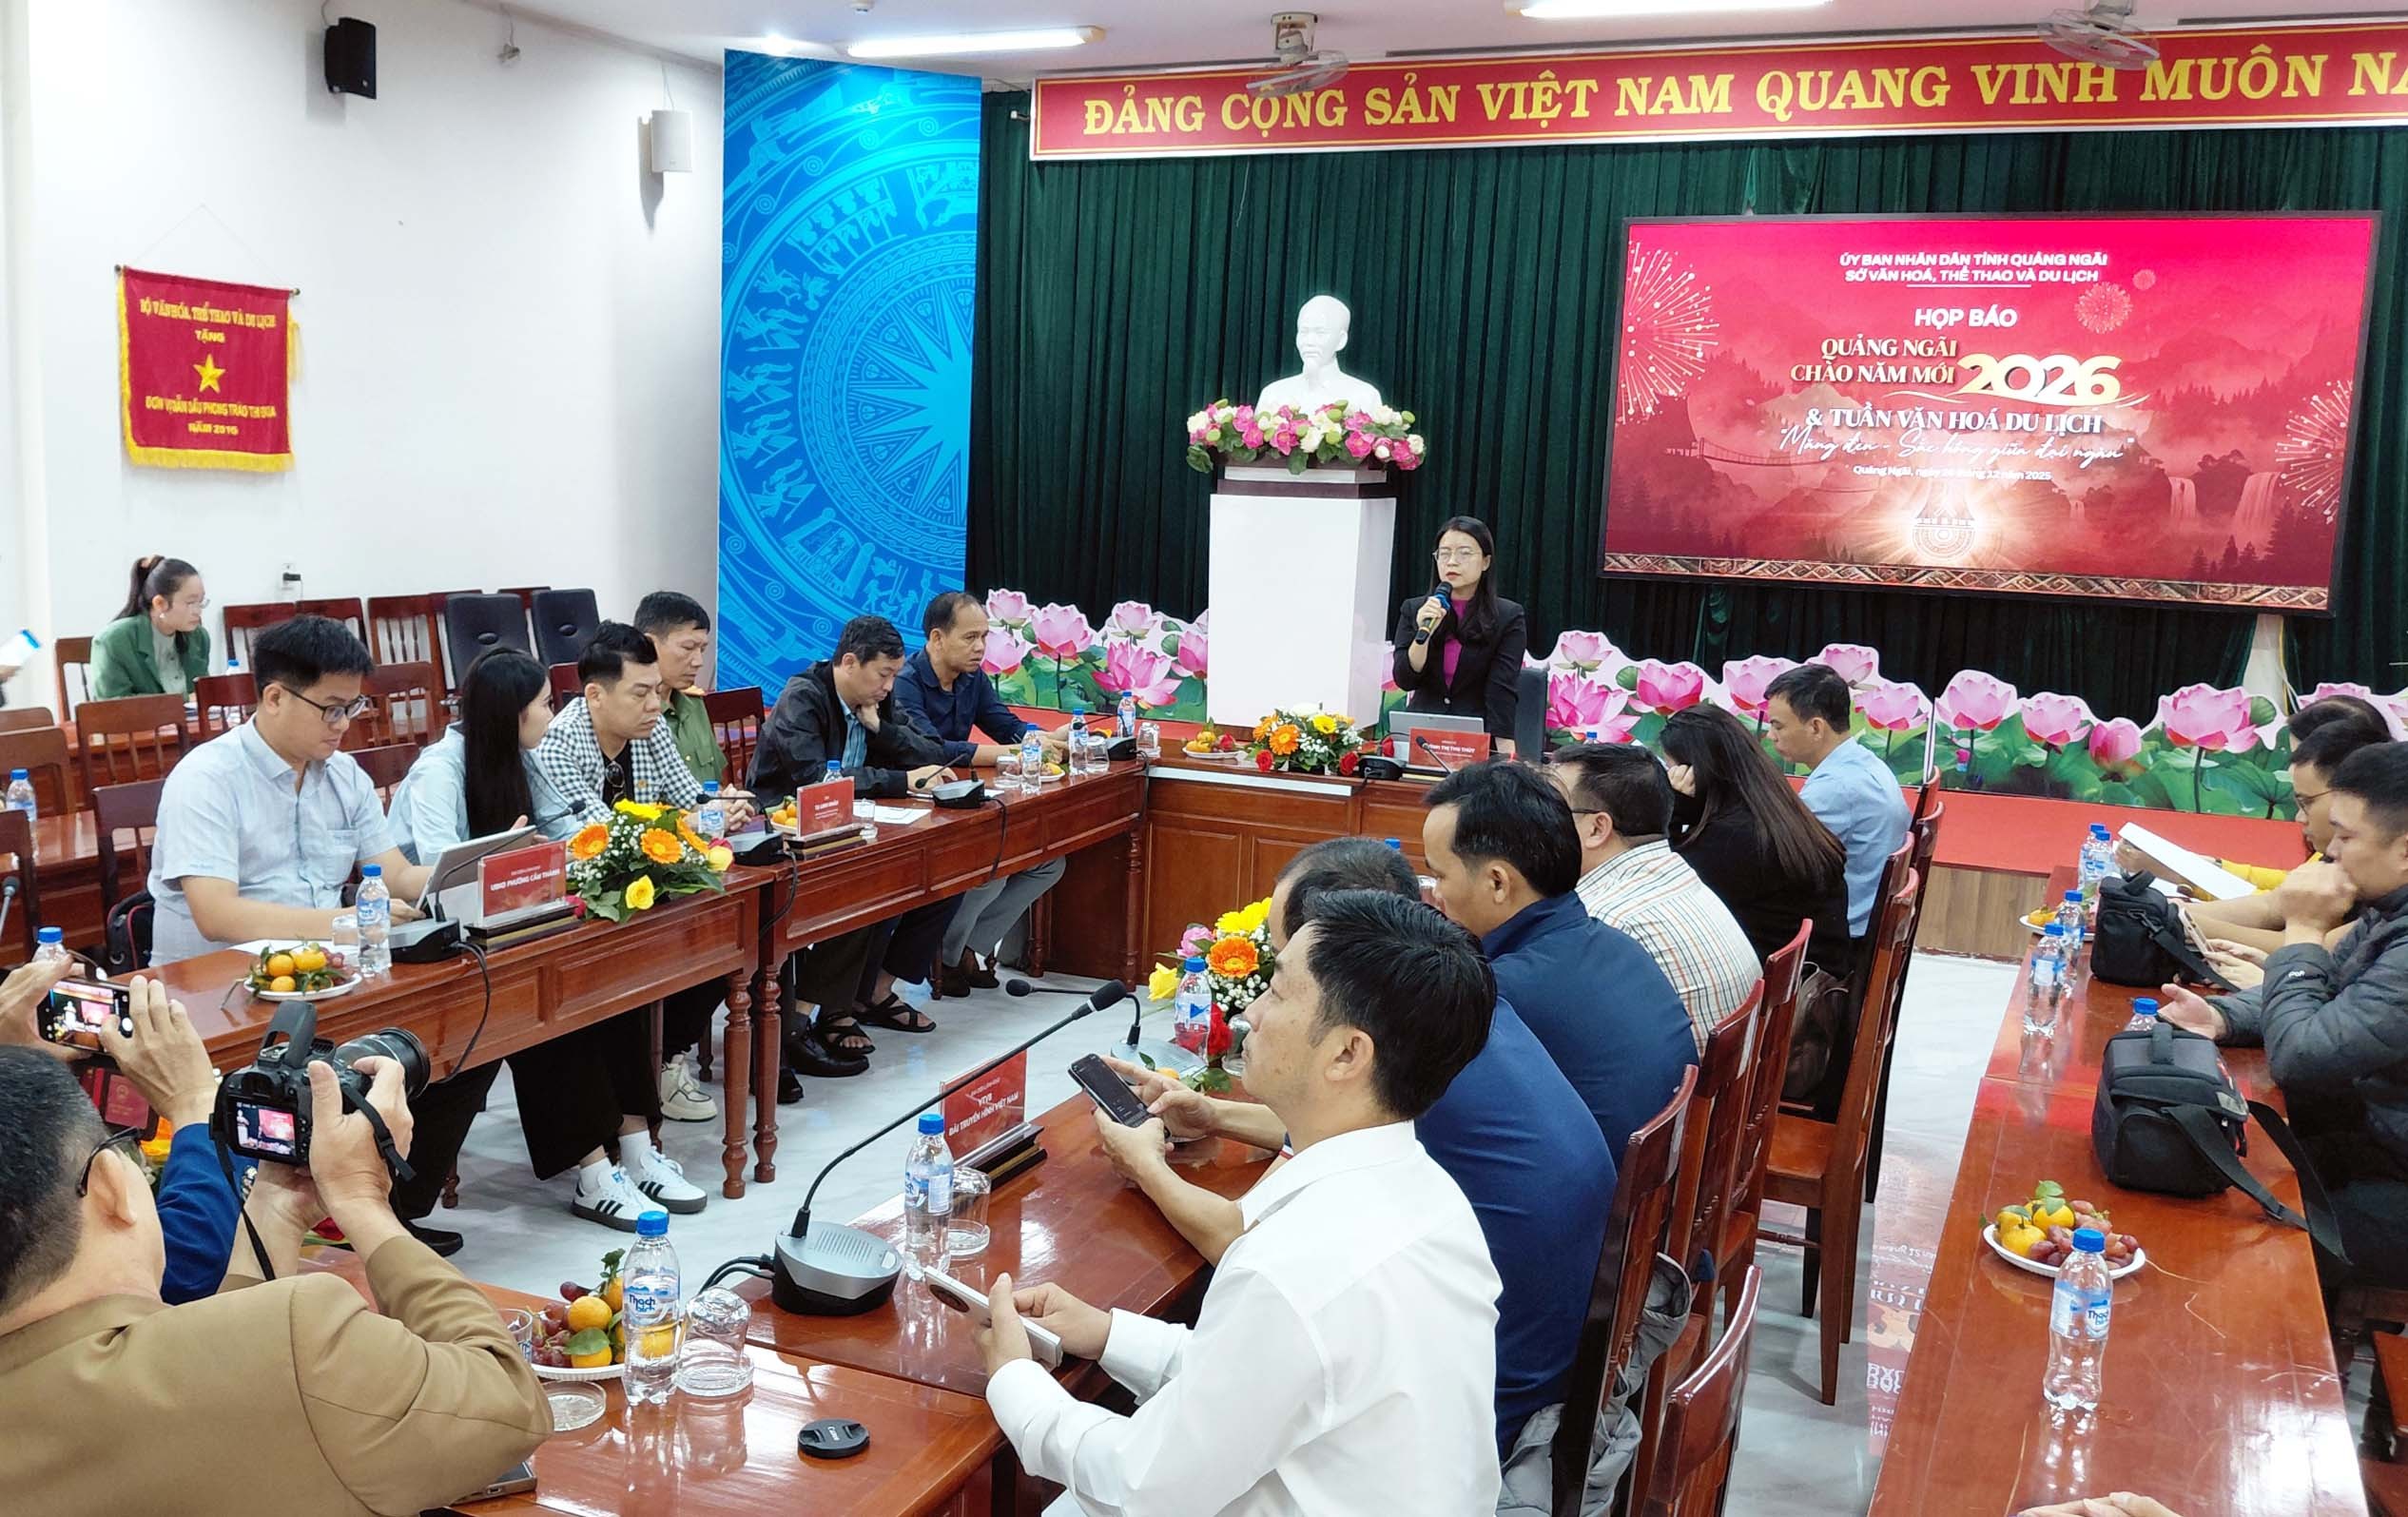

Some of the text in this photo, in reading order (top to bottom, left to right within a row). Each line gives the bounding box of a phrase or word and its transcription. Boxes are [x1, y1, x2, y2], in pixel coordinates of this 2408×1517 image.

[1083, 83, 1206, 137] ĐẢNG
[1221, 82, 1349, 138] CỘNG
[1364, 71, 1461, 126] SẢN
[1474, 69, 1599, 129] VIỆT
[1615, 73, 1734, 118] NAM
[1756, 66, 1952, 122] QUANG
[1971, 62, 2119, 105] VINH
[2139, 44, 2330, 102] MUÔN
[1861, 254, 1893, 266] BAN
[1894, 251, 1938, 266] NHÂN
[1939, 251, 1971, 266] DÂN
[2068, 251, 2107, 266] NGÃI
[1868, 267, 1900, 282] VĂN
[1971, 269, 2014, 282] THAO
[2015, 267, 2037, 282] VÀ
[2038, 269, 2062, 282] DU
[2063, 269, 2099, 284] LỊCH
[1914, 303, 2018, 330] HỌP BÁO
[1821, 335, 1958, 360] QUẢNG NGÃI
[1791, 362, 1956, 385] CHÀO NĂM MỚI
[1957, 353, 2123, 402] 2026
[1806, 400, 2103, 438] & TUẦN VĂN HOÁ DU LỊCH
[2025, 471, 2052, 480] 2025
